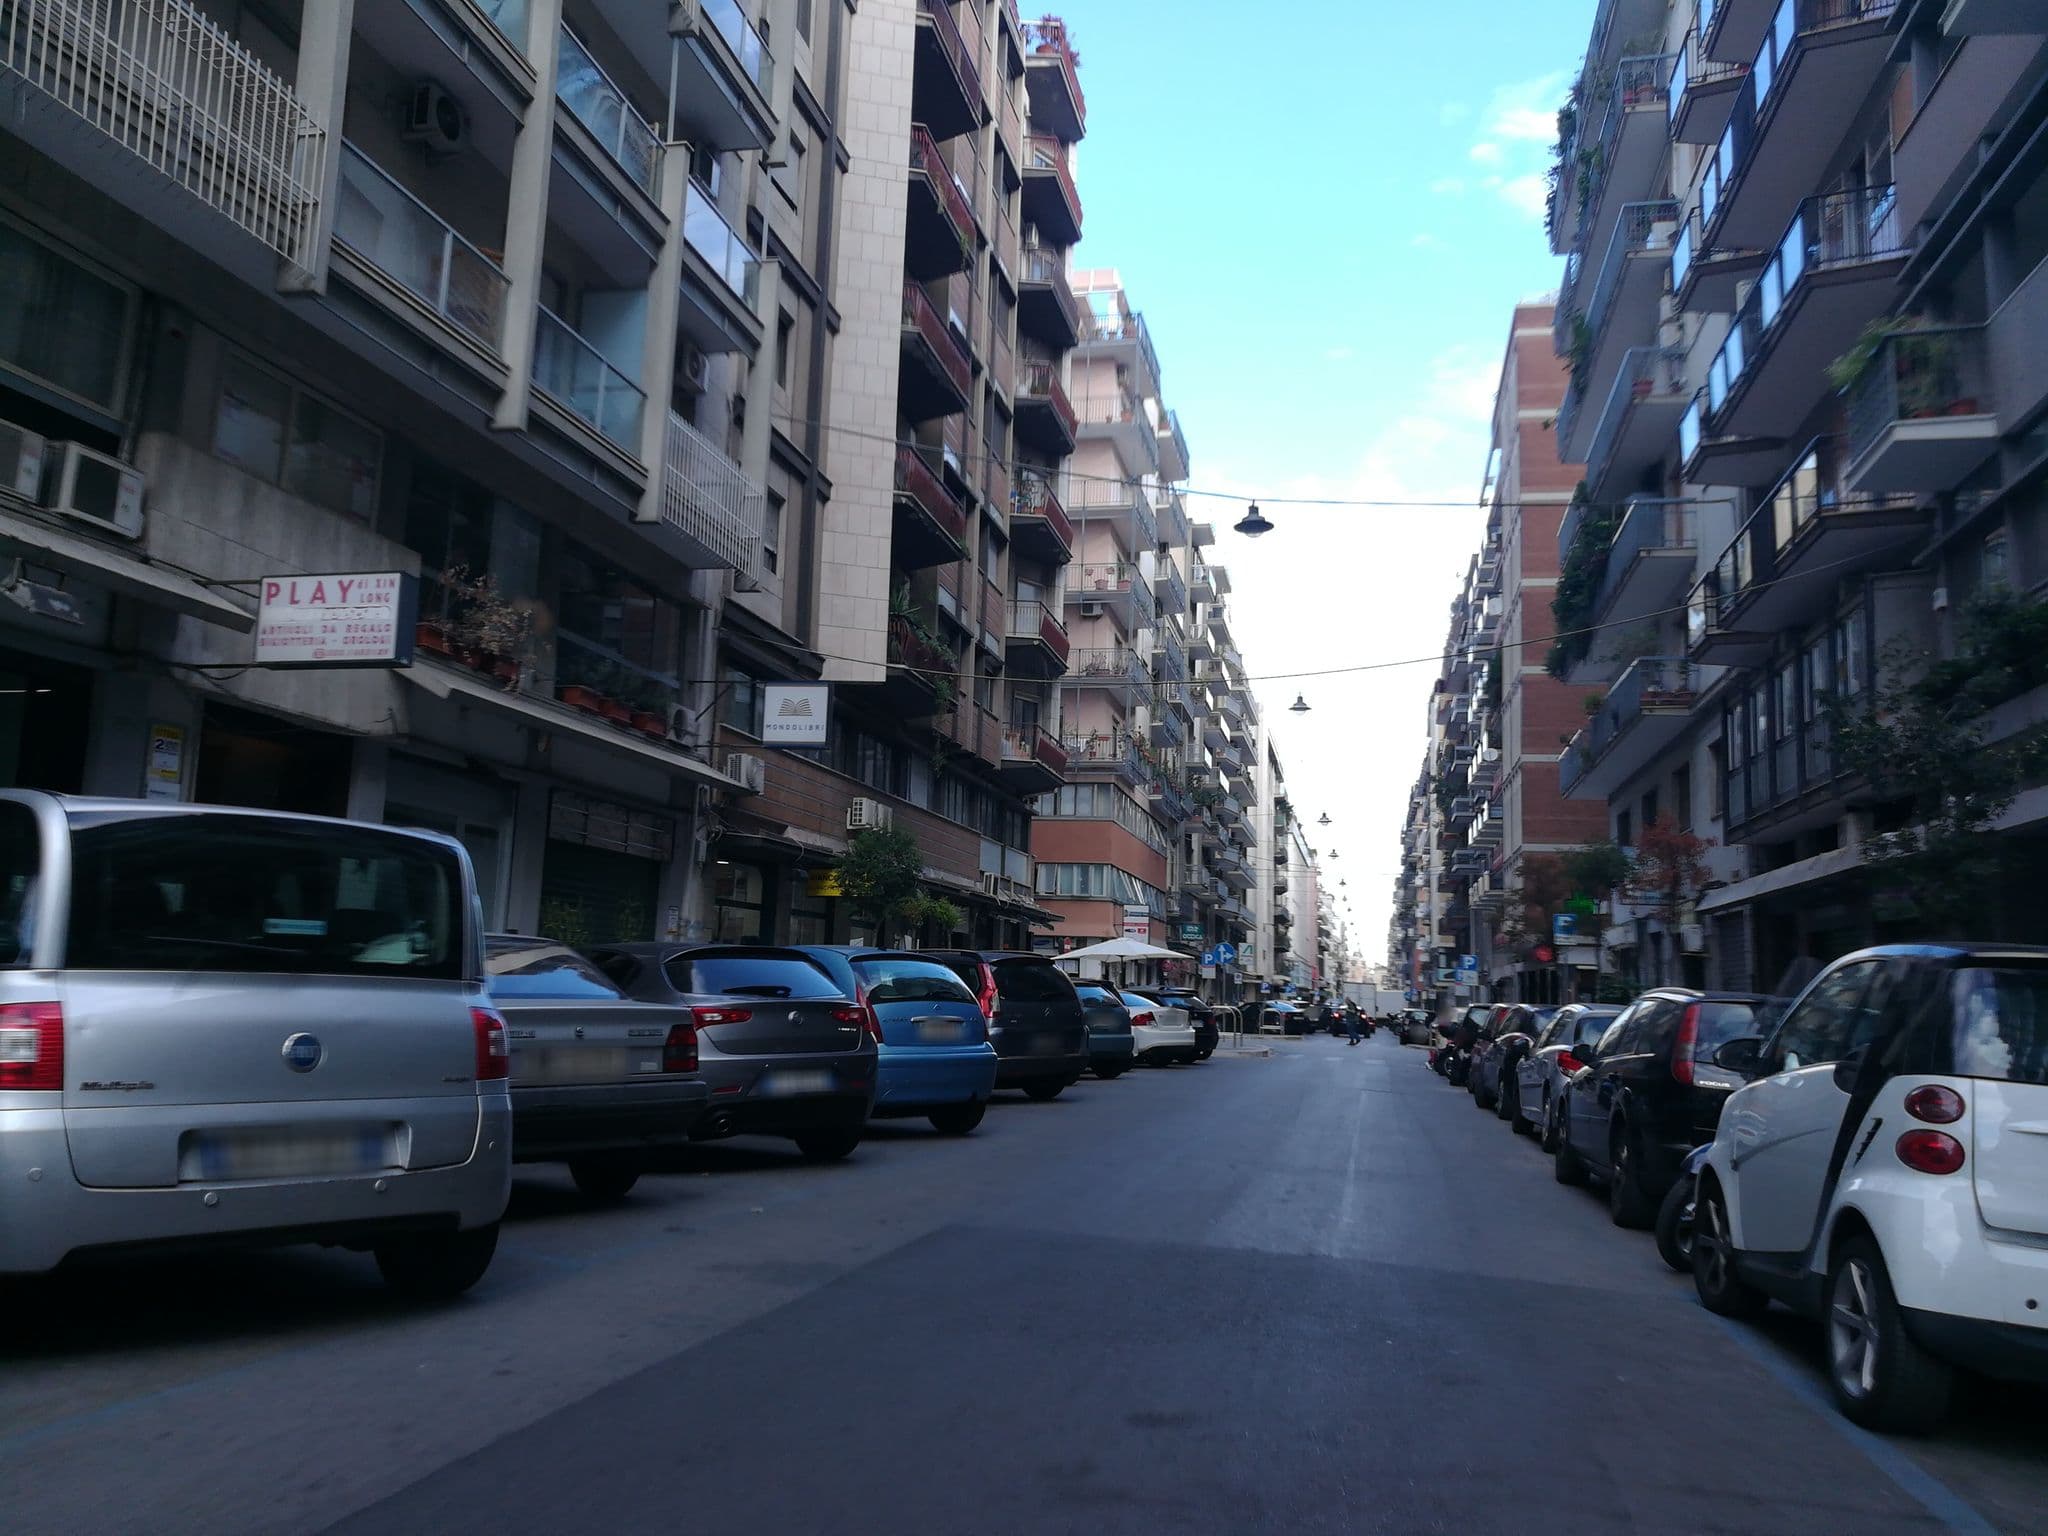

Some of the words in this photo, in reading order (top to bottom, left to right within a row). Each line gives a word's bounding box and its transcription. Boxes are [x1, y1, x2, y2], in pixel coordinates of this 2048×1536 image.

[265, 580, 354, 605] PLAY
[360, 592, 391, 604] LONG
[1204, 953, 1214, 965] P
[1463, 956, 1475, 969] P
[1699, 1080, 1731, 1088] FOCUS
